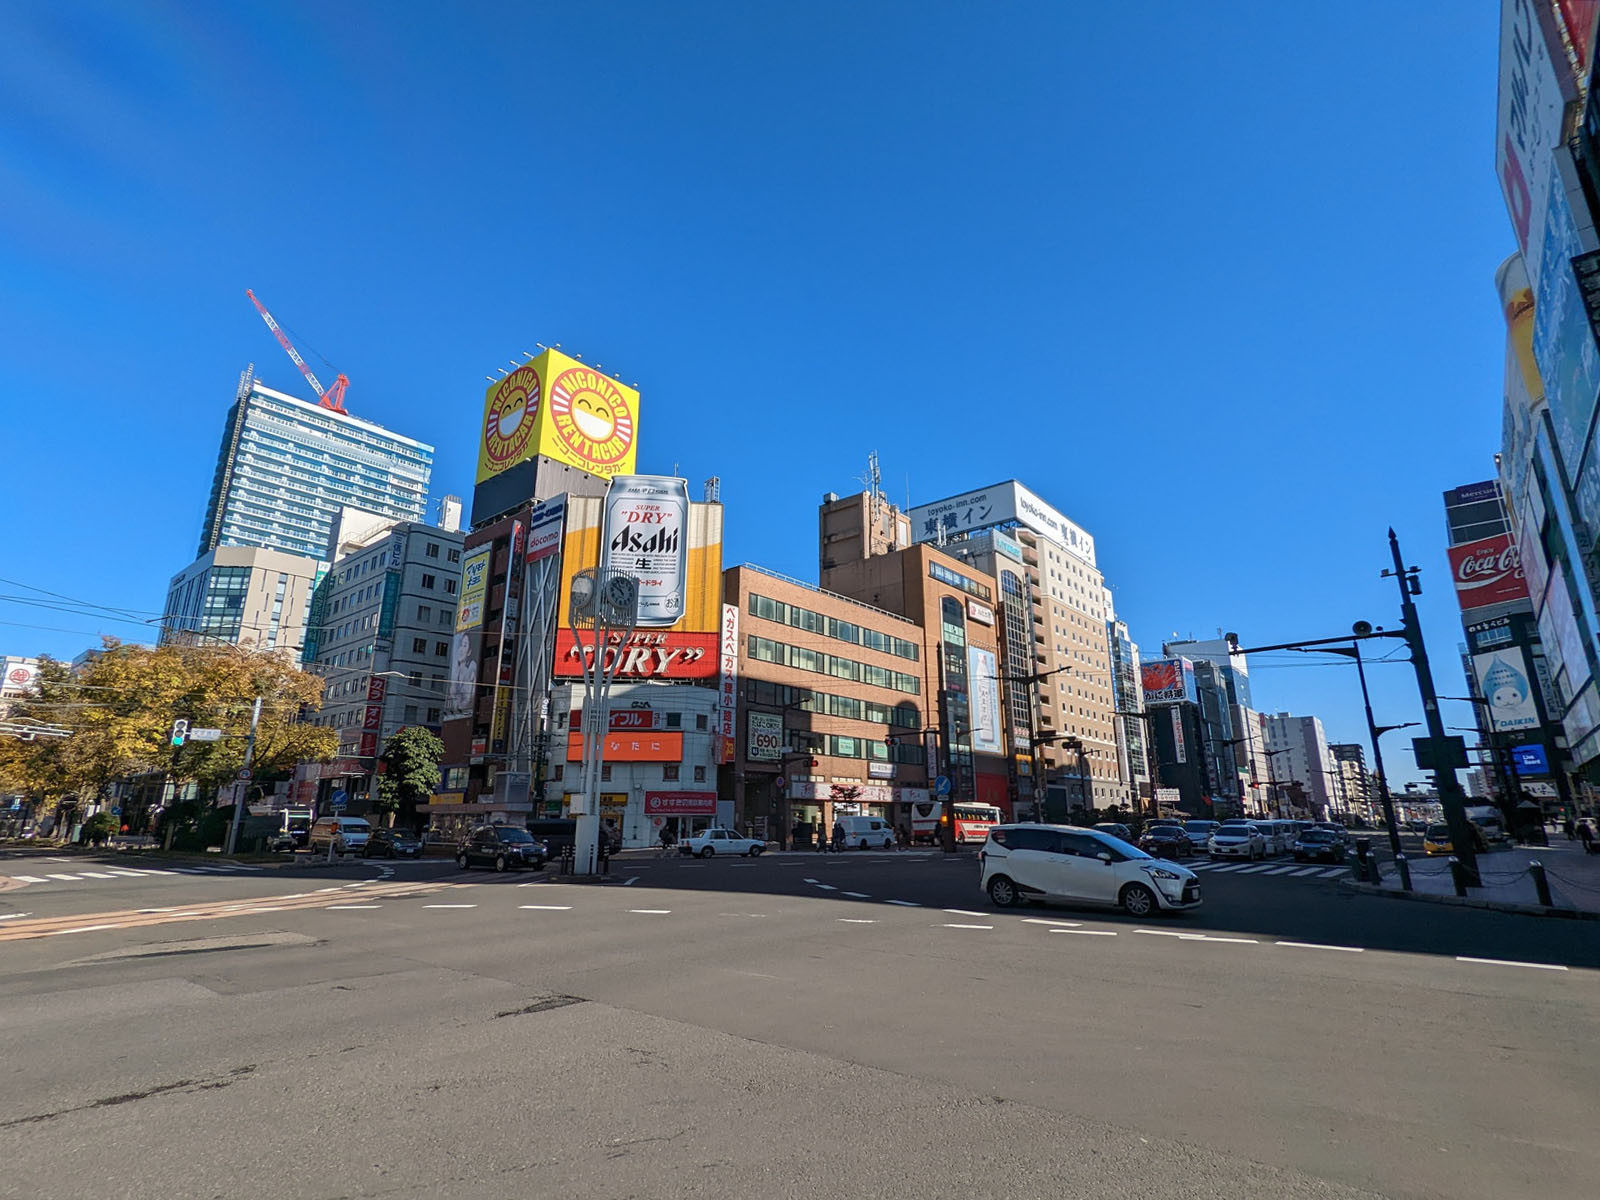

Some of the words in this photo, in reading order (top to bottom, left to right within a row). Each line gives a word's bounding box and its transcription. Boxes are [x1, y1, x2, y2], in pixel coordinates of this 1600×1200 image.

[492, 370, 536, 412] NICONICO
[562, 373, 628, 416] NICONICO
[489, 414, 533, 457] RENTACAR
[556, 413, 626, 461] RENTACAR
[551, 435, 627, 474] ニコニコレンタカー
[923, 504, 994, 537] 東横イン
[927, 494, 987, 516] toyoko-inn.com
[1020, 496, 1058, 530] toyoko-inn.com
[530, 531, 559, 548] docomo
[611, 525, 679, 553] Asahi
[1060, 522, 1092, 555] 東横イン
[635, 557, 652, 570] 生
[610, 632, 668, 644] SUPER
[1500, 717, 1536, 728] DAIKIN
[756, 734, 778, 749] 690
